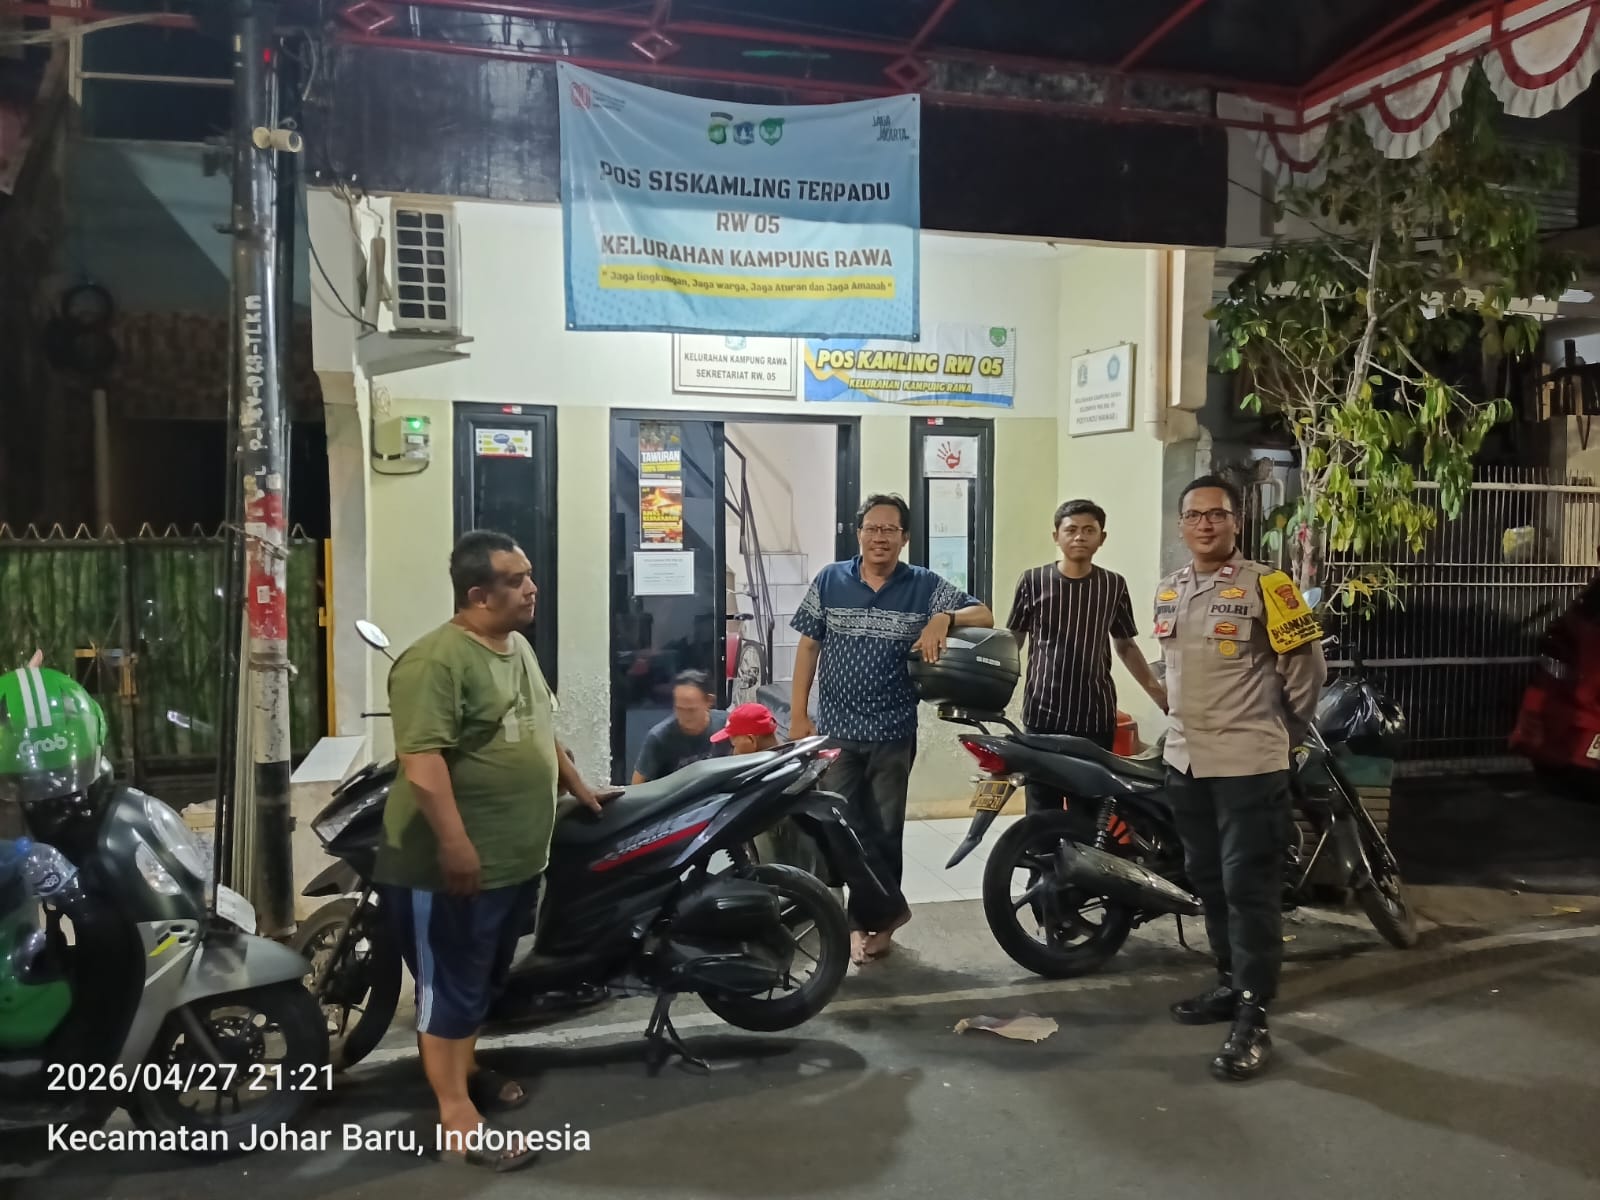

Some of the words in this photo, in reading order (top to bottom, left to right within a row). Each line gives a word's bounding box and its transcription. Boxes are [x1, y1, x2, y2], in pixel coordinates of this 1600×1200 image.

[600, 160, 641, 189] POS
[649, 170, 791, 200] SISKAMLING
[797, 180, 890, 202] TERPADU
[716, 212, 749, 232] RW
[754, 214, 780, 234] 05
[602, 235, 724, 266] KELURAHAN
[730, 249, 829, 268] KAMPUNG
[835, 248, 892, 268] RAWA
[809, 282, 824, 291] dan
[684, 352, 728, 363] KELURAHAN
[730, 355, 766, 366] KAMPUNG
[767, 356, 788, 366] RAWA
[816, 349, 854, 369] POS
[857, 350, 939, 373] KAMLING
[944, 355, 975, 375] RW
[979, 356, 1003, 376] 05
[696, 368, 749, 380] SEKRETARIAT
[751, 371, 765, 381] RW.
[767, 372, 776, 381] 05
[848, 378, 900, 390] KELURAHAN
[902, 380, 946, 393] KAMPUNG
[946, 383, 972, 394] RAWA
[641, 450, 680, 463] TAWURAN
[1210, 604, 1249, 616] POLRI
